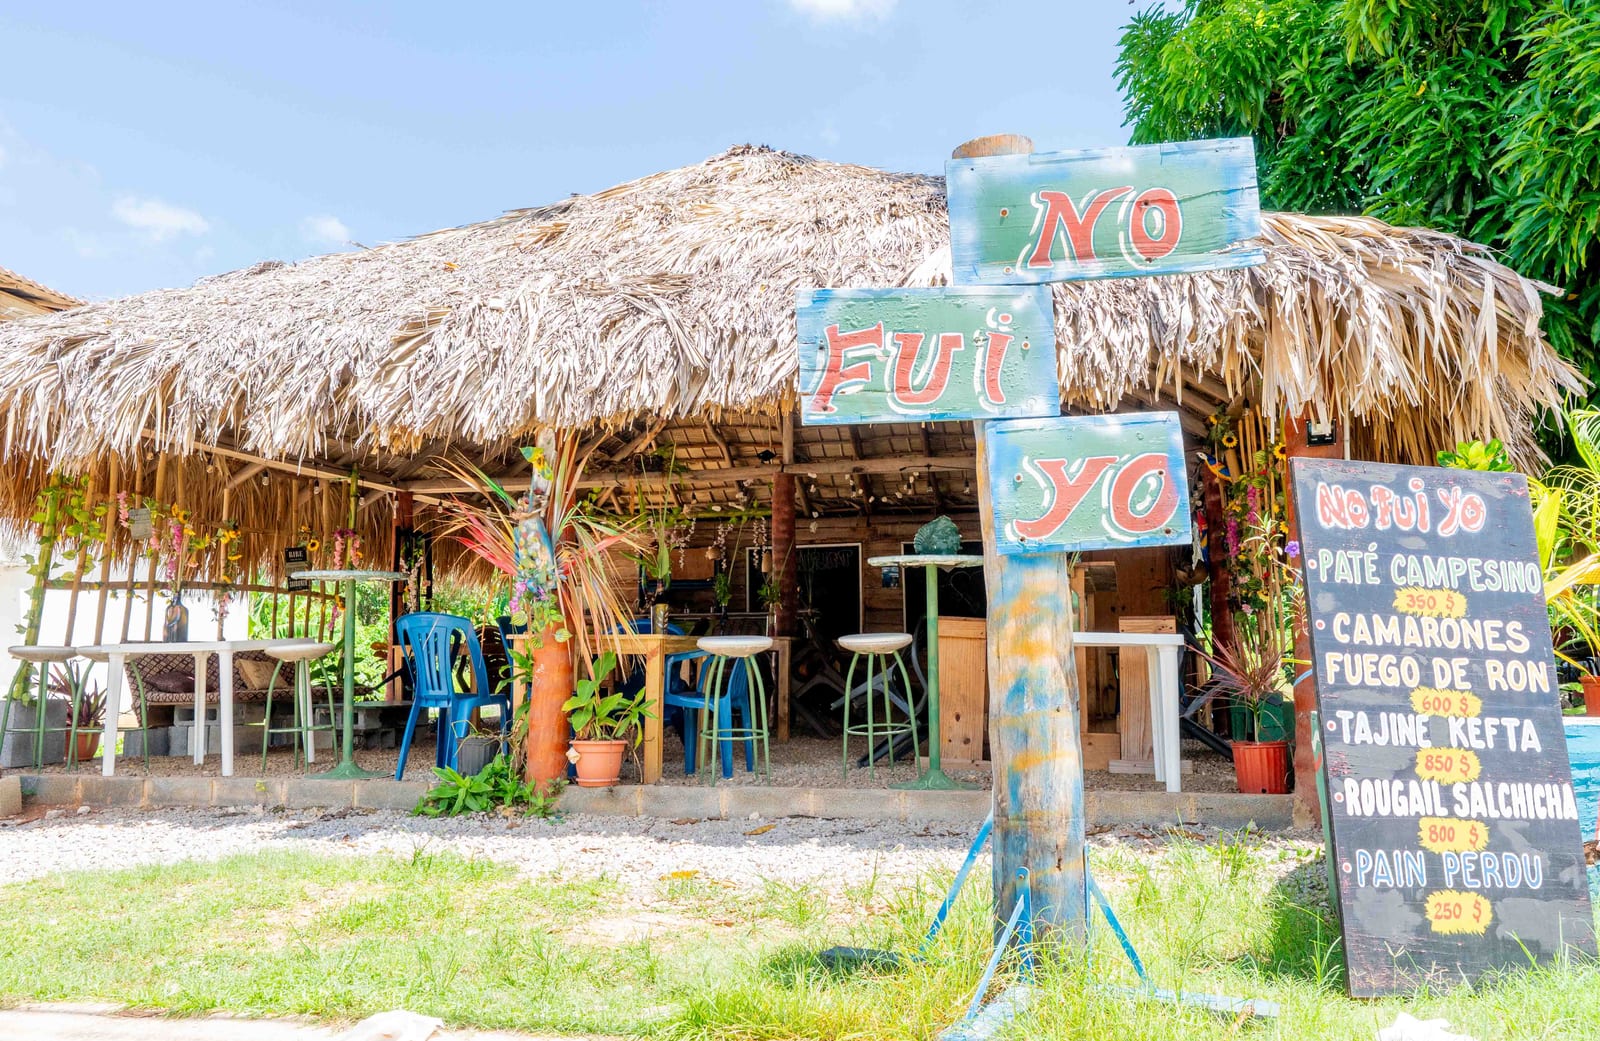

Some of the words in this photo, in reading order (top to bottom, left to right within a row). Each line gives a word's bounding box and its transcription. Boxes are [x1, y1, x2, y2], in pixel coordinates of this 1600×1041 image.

[1019, 186, 1183, 270] NO
[1010, 452, 1182, 543] YO
[1318, 542, 1381, 585] PATÉ
[1390, 554, 1542, 595] CAMPESINO
[1405, 593, 1438, 611] 350
[1445, 593, 1456, 613] $
[1332, 612, 1531, 654] CAMARONES
[1325, 652, 1420, 688] FUEGO
[1432, 657, 1472, 691] DE
[1485, 659, 1551, 693] RON
[1421, 692, 1453, 713] 600
[1459, 693, 1470, 715] $
[1335, 709, 1432, 748] TAJINE
[1447, 715, 1542, 753] KEFTA
[1424, 754, 1454, 773] 850
[1459, 754, 1472, 777] $
[1343, 777, 1449, 817] ROUGAIL
[1452, 781, 1579, 820] SALCHICHA
[1428, 824, 1456, 843] 800
[1468, 824, 1480, 848] $
[1356, 848, 1427, 888] PAIN
[1441, 851, 1544, 890] PERDU
[1433, 900, 1463, 921] 250
[1471, 899, 1483, 924] $
